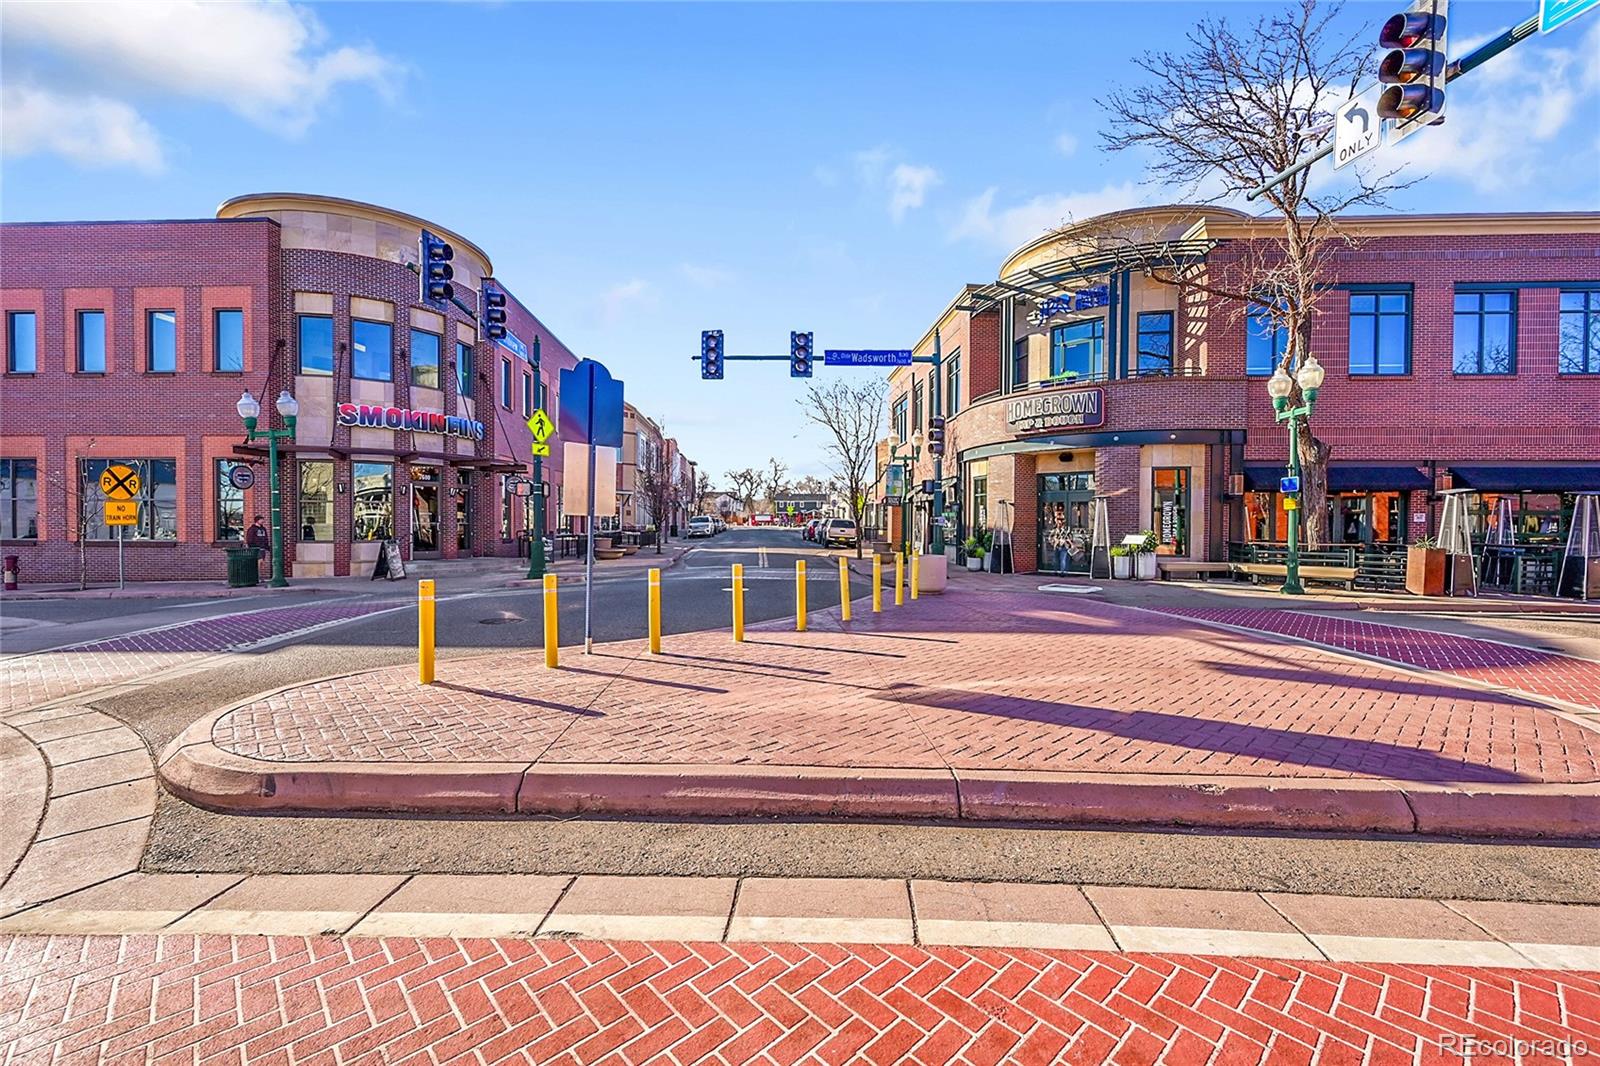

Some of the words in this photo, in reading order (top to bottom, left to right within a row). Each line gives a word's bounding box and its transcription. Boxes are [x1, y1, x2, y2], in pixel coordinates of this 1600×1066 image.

[1339, 132, 1373, 161] ONLY
[851, 352, 897, 363] Wadsworth
[1008, 391, 1098, 422] HOMEGROWN
[338, 402, 447, 434] SMOKIN
[446, 415, 486, 441] FINS
[1016, 419, 1035, 430] TAP
[1034, 418, 1045, 429] &
[1044, 414, 1085, 427] DOUGH
[103, 476, 112, 486] R
[129, 479, 137, 489] R
[116, 504, 126, 512] NO
[1162, 500, 1173, 543] HOMEGROWN
